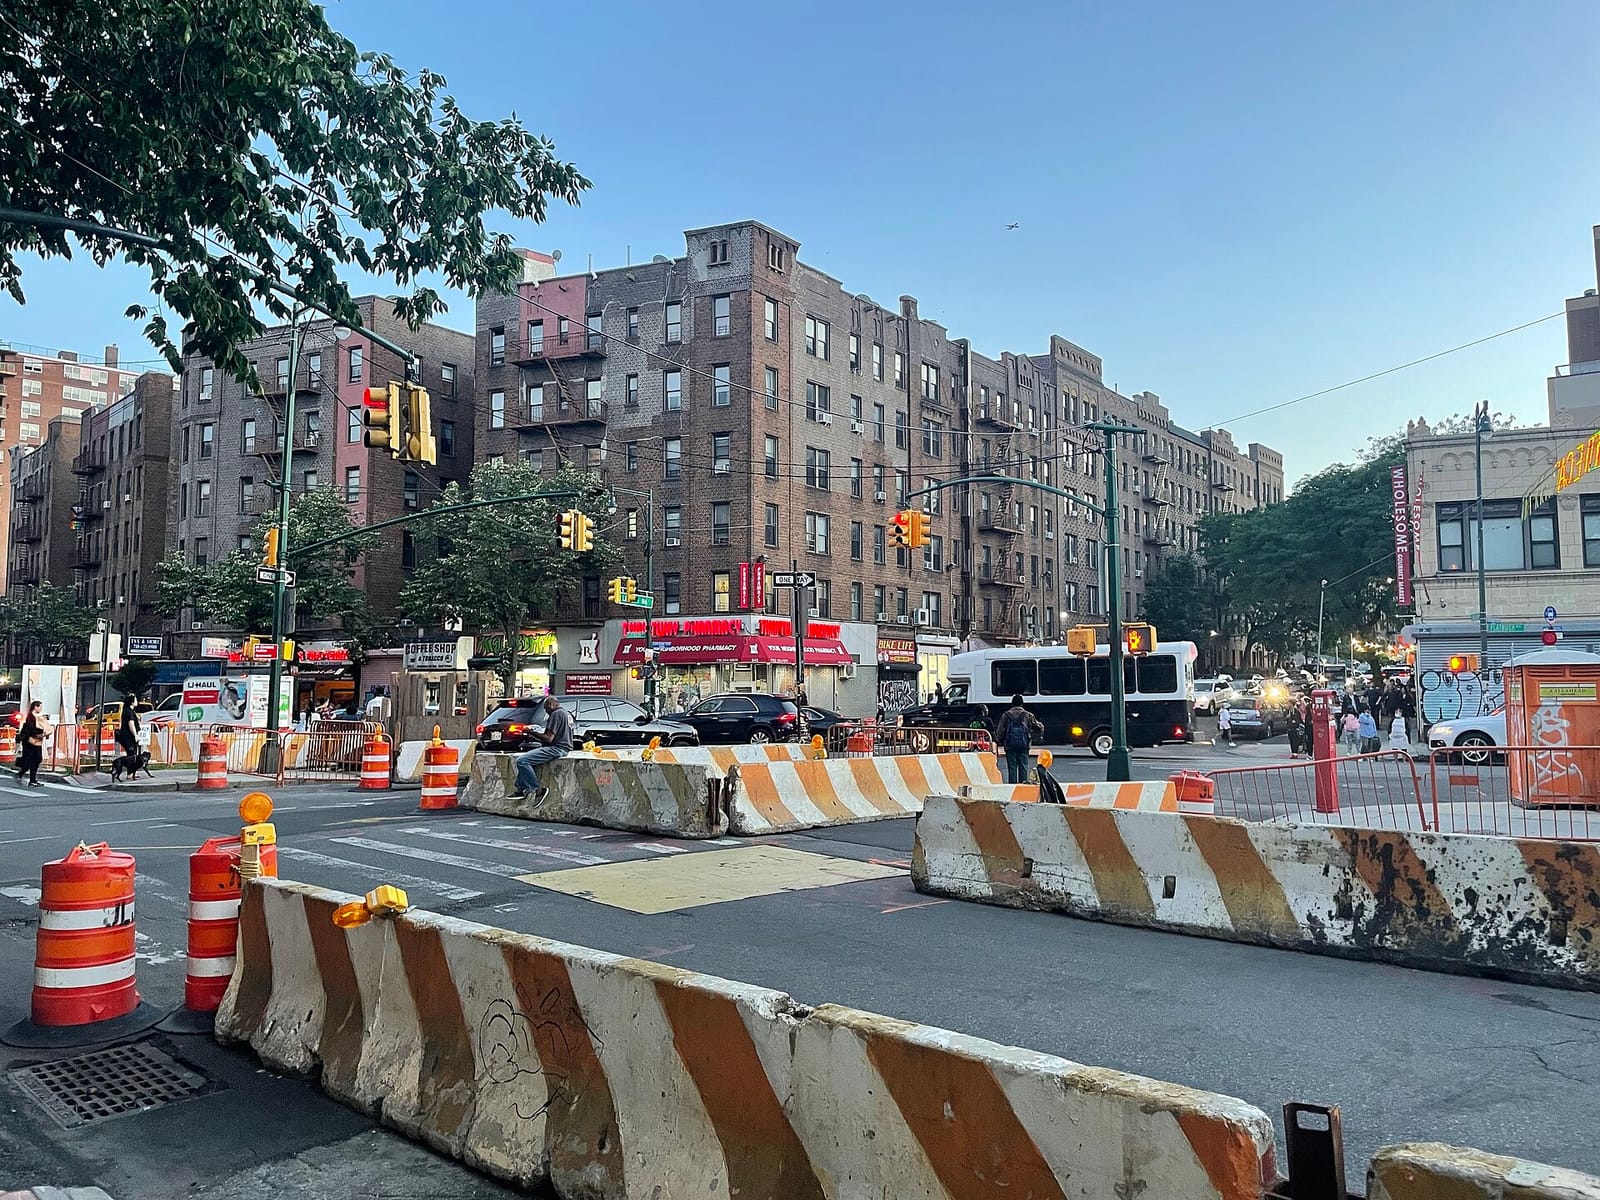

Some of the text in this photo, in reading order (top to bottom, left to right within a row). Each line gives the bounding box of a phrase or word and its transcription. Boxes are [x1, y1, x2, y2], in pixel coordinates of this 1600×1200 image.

[1392, 468, 1408, 553] WHOLESOME
[778, 575, 792, 583] ONE
[405, 643, 457, 655] COFFEE SHOP
[702, 644, 737, 652] PHARMACY
[878, 640, 914, 650] BIKE LIFE
